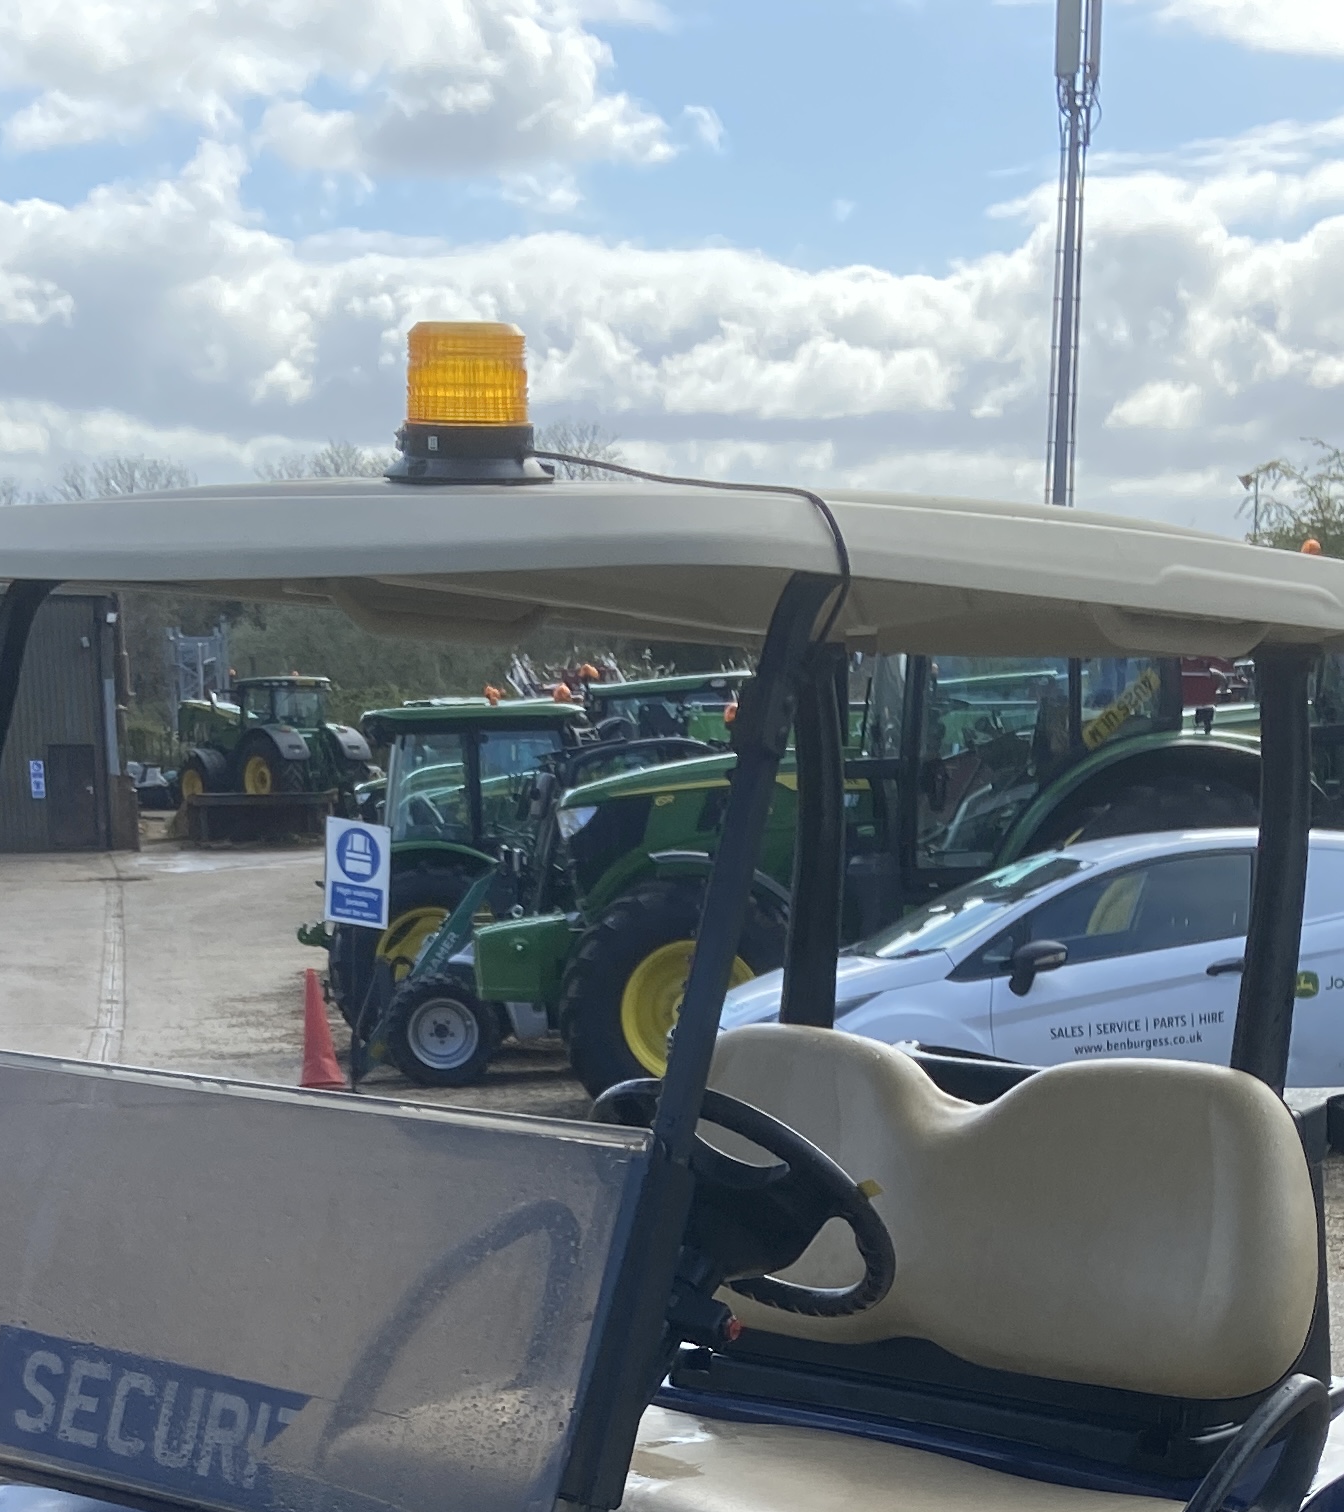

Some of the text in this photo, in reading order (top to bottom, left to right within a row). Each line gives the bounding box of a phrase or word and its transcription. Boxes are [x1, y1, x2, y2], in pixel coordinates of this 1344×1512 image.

[1050, 1010, 1224, 1040] SALES SERVICE PARTS HIRE
[1074, 1031, 1203, 1056] www.benburgess.co.uk
[14, 1350, 298, 1490] SECURI
